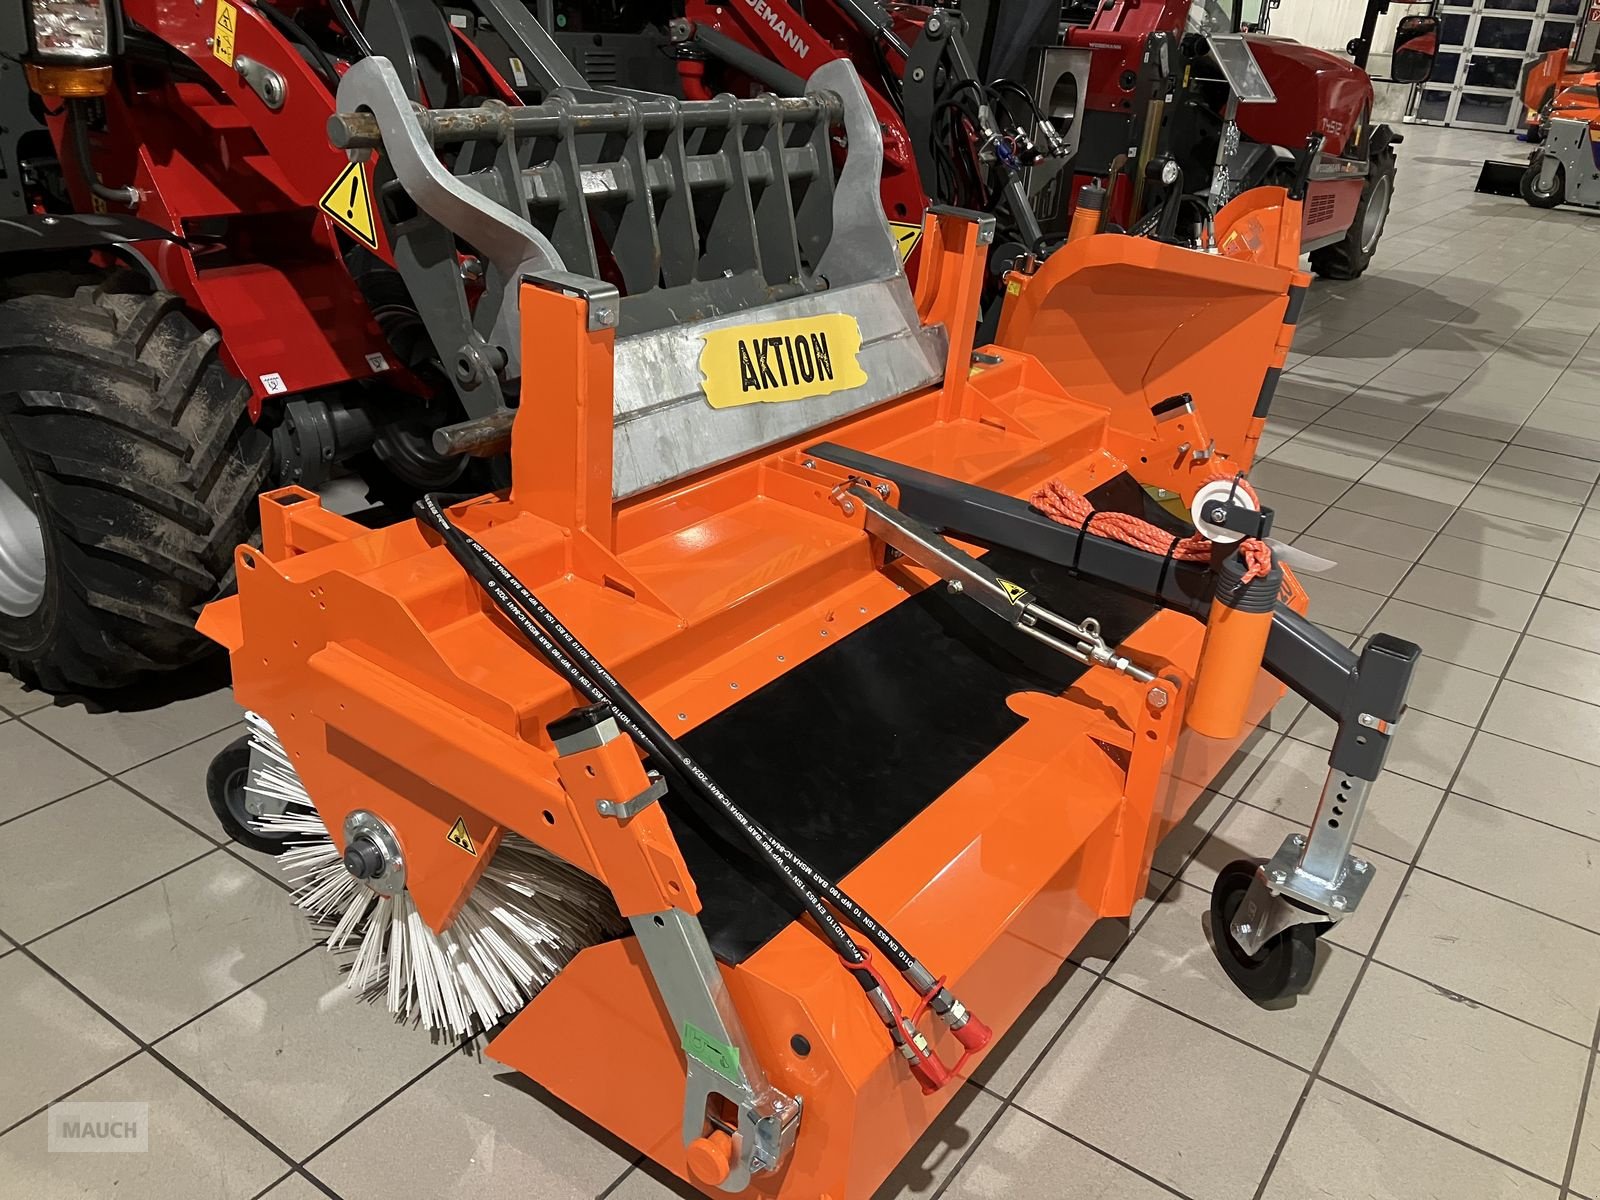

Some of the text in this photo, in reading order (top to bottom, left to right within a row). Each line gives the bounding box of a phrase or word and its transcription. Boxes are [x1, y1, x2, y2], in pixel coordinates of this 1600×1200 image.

[738, 332, 834, 392] AKTION
[510, 578, 522, 589] BAR
[544, 613, 555, 624] 1SN
[524, 620, 540, 636] MSHA
[539, 636, 552, 649] BAR
[563, 631, 573, 642] EN
[551, 649, 562, 659] 180
[572, 642, 590, 659] HD110
[560, 659, 571, 669] WP
[571, 668, 579, 676] 10
[578, 676, 591, 688] 1SN
[591, 688, 603, 699] 853
[611, 706, 631, 725] HD110
[708, 783, 731, 807] IC-84/41
[730, 805, 748, 825] MSHA
[747, 825, 762, 841] BAR
[761, 841, 773, 854] 180
[768, 837, 793, 859] IC-84/41
[772, 853, 784, 866] WP
[793, 856, 812, 875] MSHA
[782, 865, 792, 875] 10
[792, 876, 805, 890] 1SN
[813, 873, 829, 888] BAR
[806, 891, 818, 904] 853
[829, 887, 841, 899] 180
[815, 903, 826, 915] EN
[841, 898, 852, 909] WP
[853, 908, 862, 917] 10
[826, 915, 845, 938] HD110
[863, 917, 876, 930] 1SN
[877, 930, 890, 943] 853
[888, 940, 899, 952] EN
